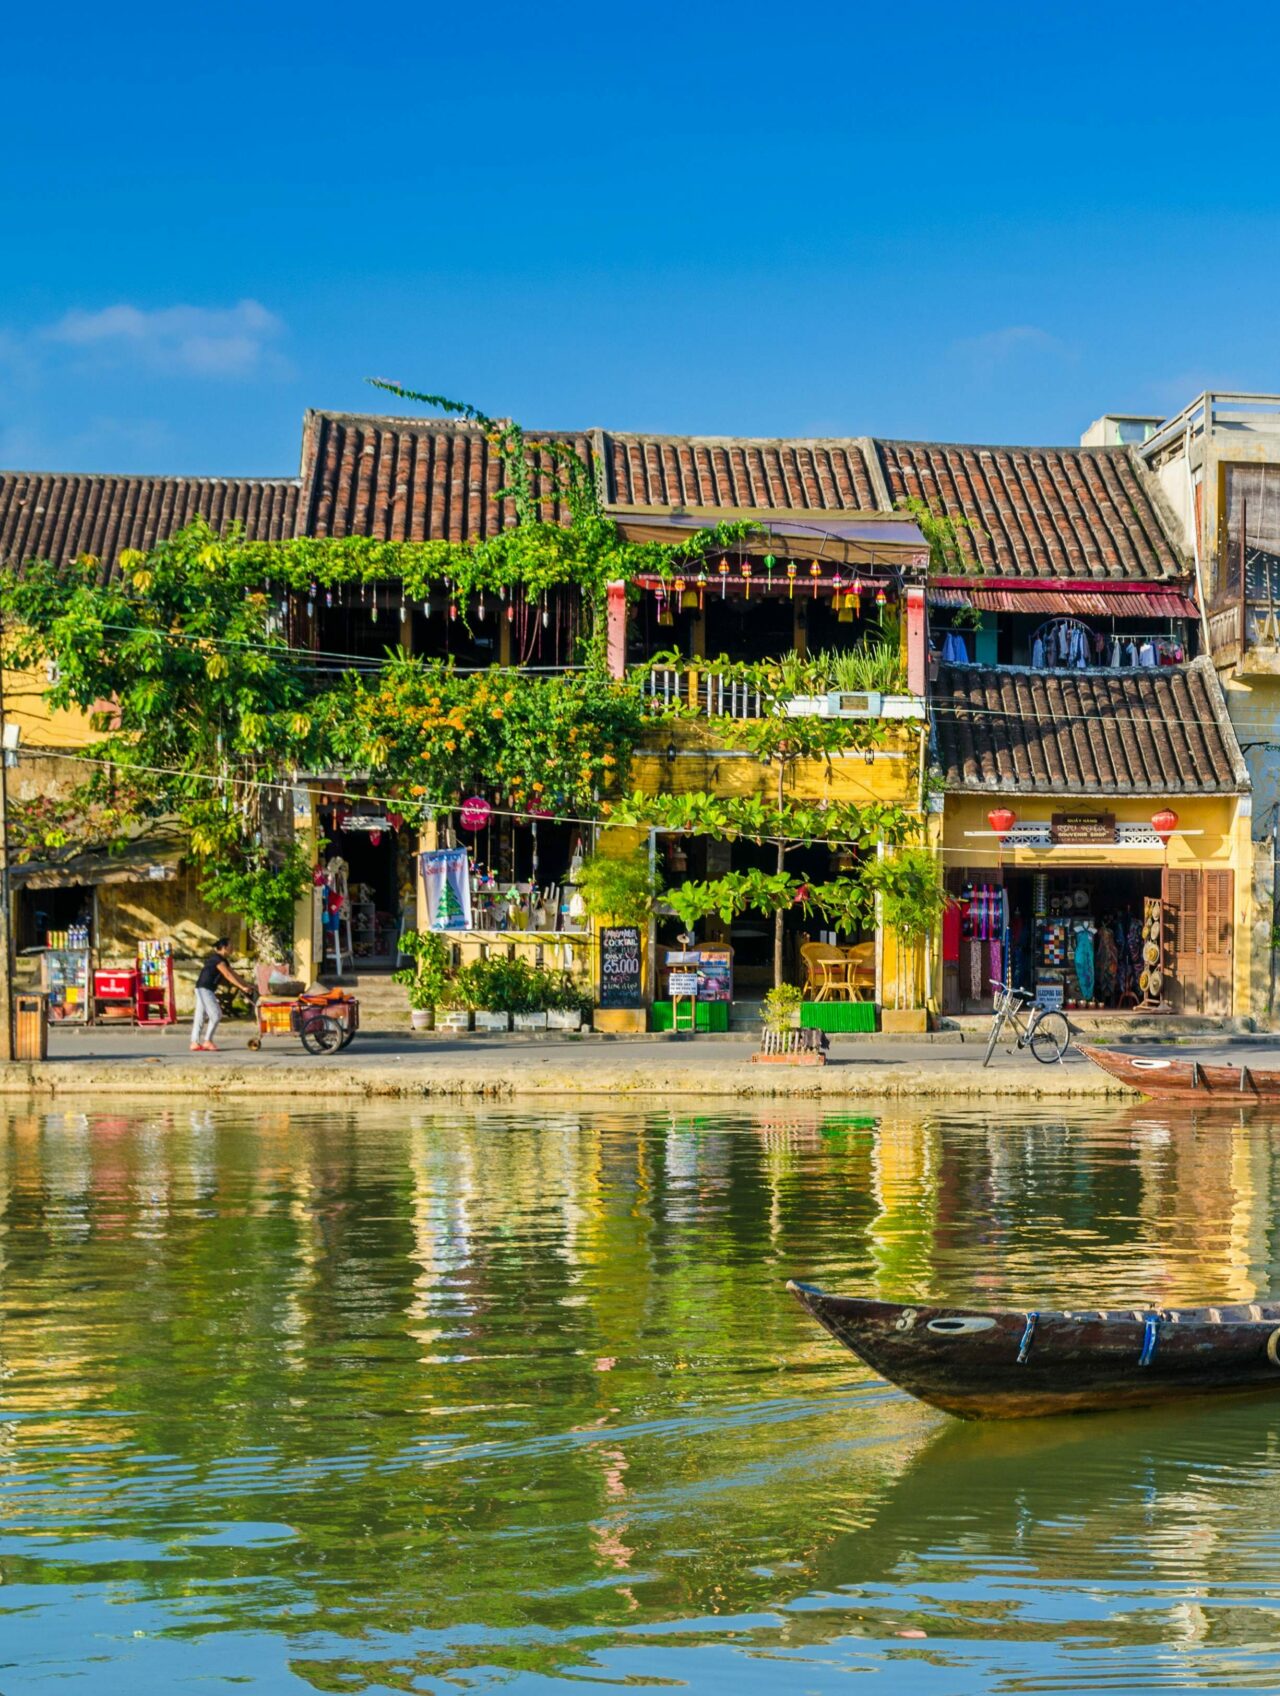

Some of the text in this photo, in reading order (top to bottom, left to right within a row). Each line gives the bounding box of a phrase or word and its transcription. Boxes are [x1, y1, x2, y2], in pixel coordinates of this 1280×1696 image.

[603, 939, 638, 947] COCKTAIL
[603, 959, 639, 974] 65.000
[895, 1308, 918, 1331] 3
